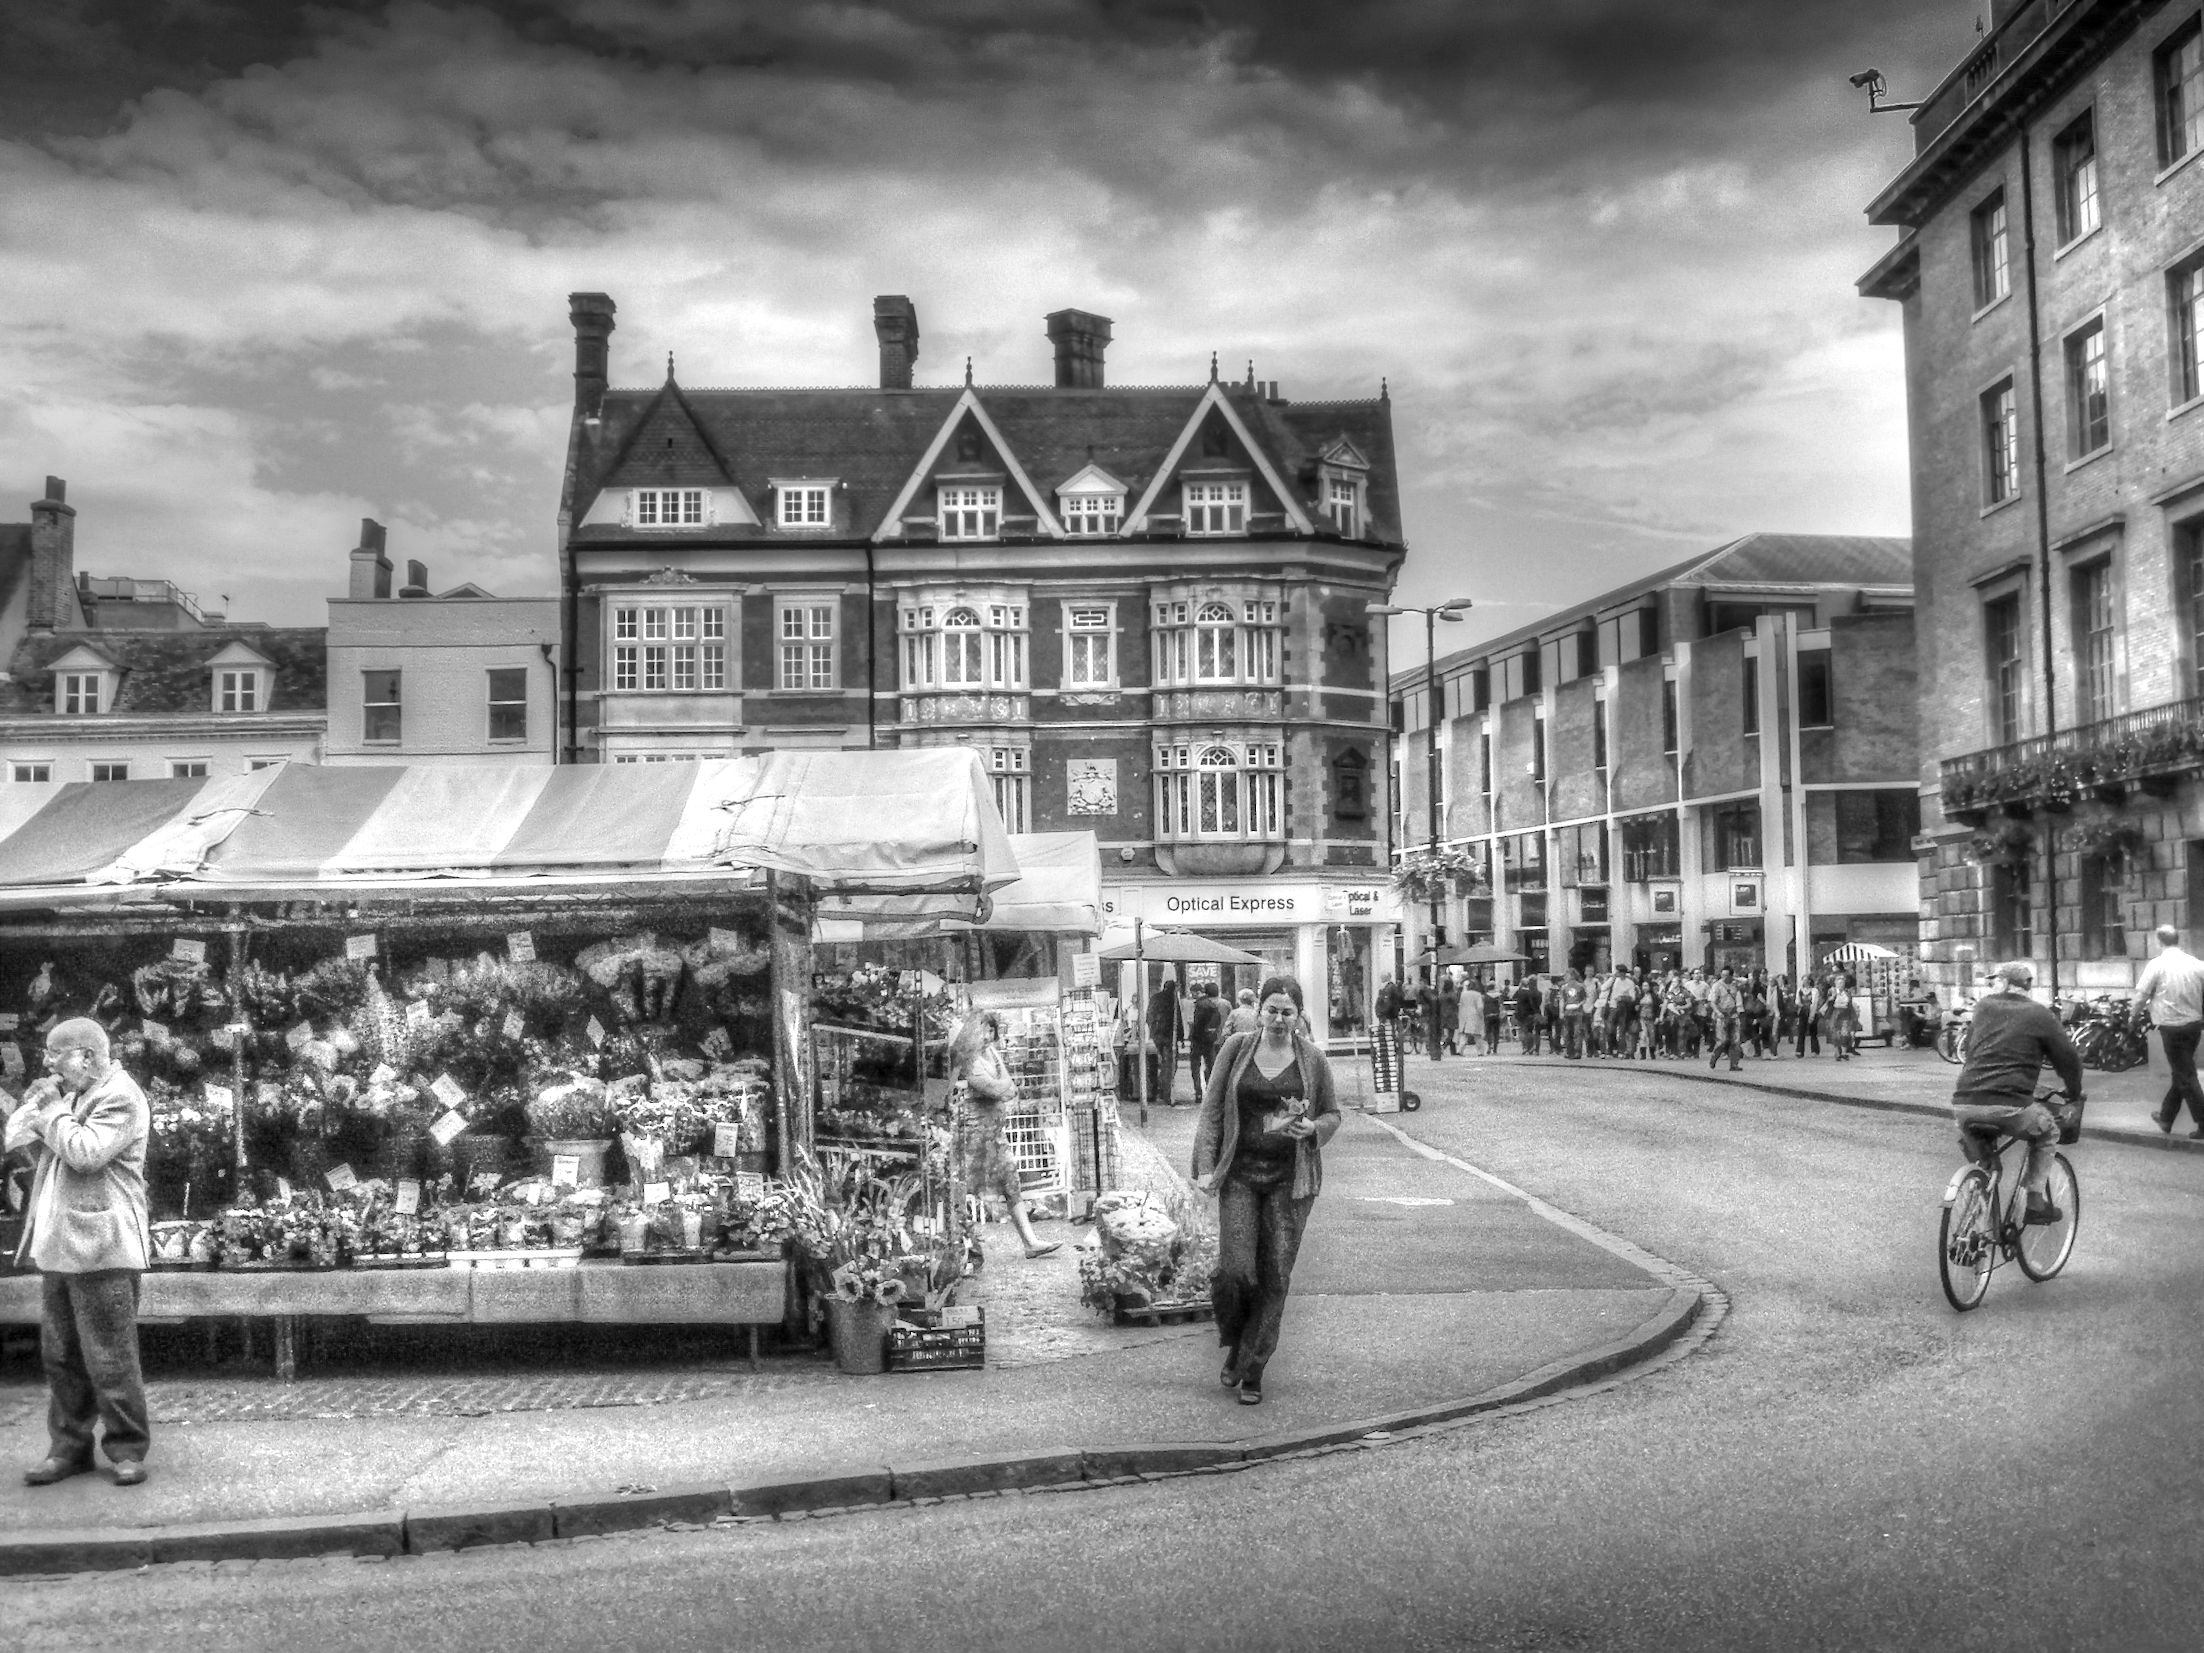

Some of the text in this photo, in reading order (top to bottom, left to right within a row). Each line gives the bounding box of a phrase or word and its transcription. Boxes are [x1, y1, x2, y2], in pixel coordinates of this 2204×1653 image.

[1343, 890, 1371, 904] ptical
[1167, 895, 1295, 914] Optical Express
[1349, 904, 1372, 916] Laser
[1188, 966, 1218, 978] SAVE
